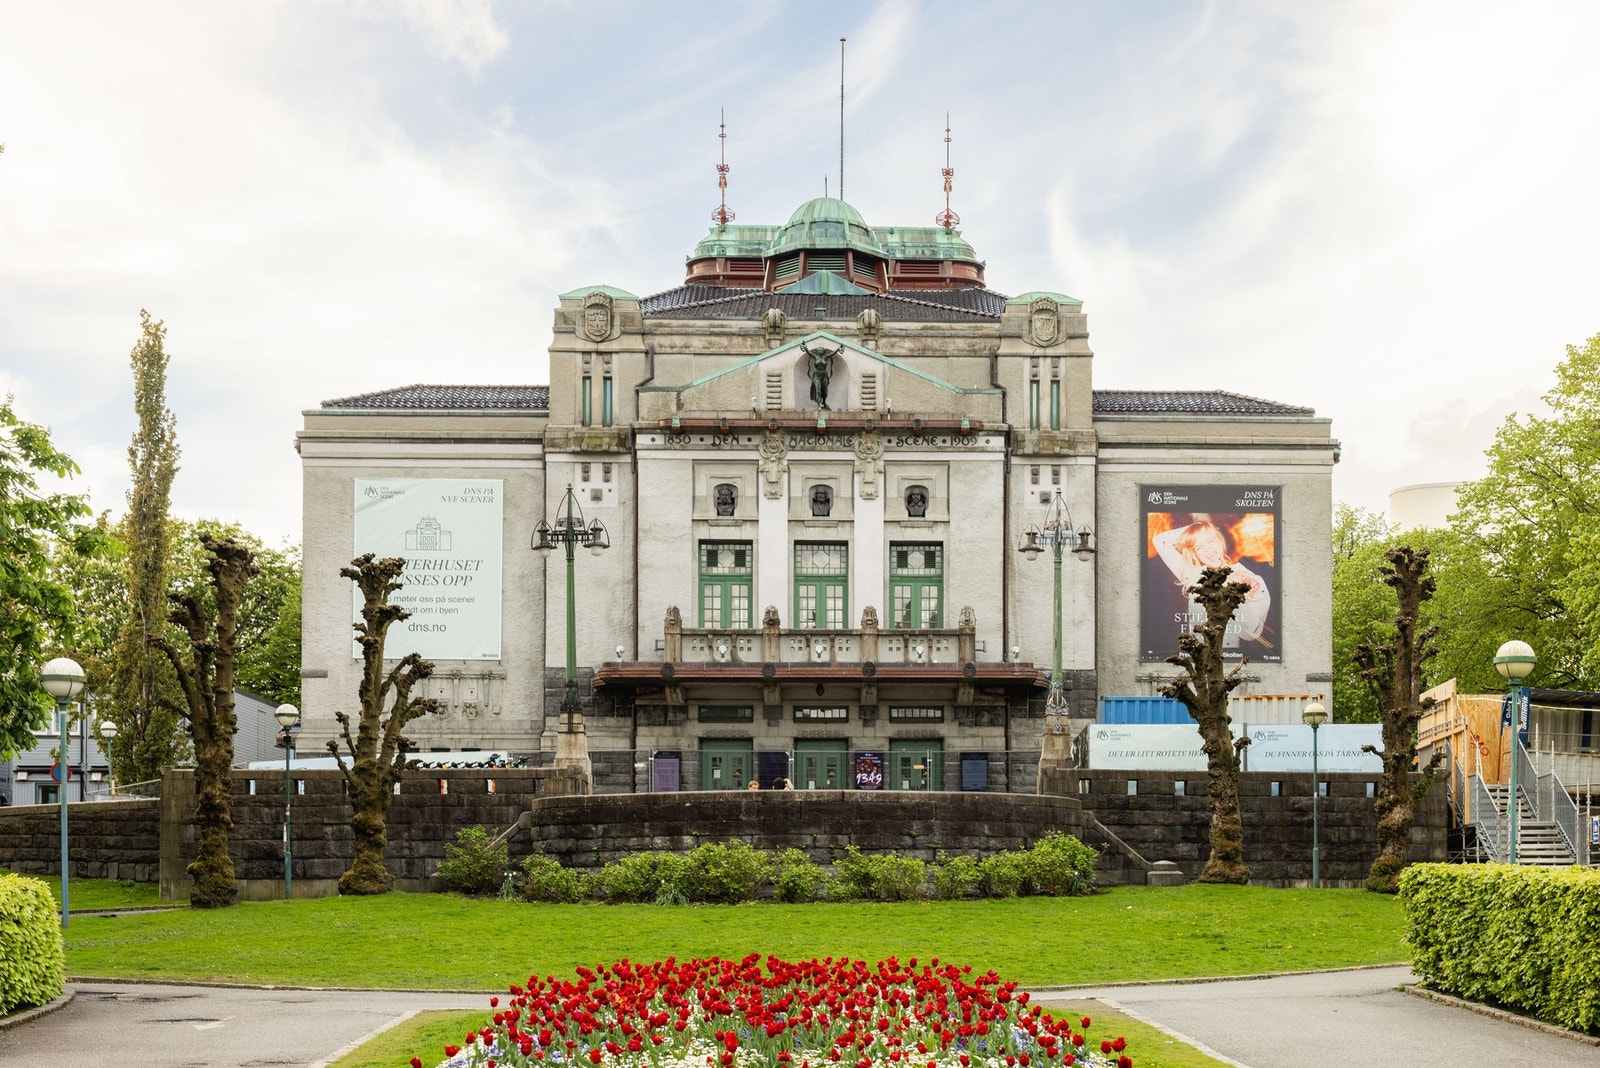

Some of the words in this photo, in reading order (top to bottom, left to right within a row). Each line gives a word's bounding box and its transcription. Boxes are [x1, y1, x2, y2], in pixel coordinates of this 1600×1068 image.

[664, 434, 691, 445] 1850
[711, 434, 739, 447] DEN
[896, 434, 939, 447] SCENE
[950, 435, 978, 446] 1909
[464, 487, 482, 495] DNS
[1243, 491, 1263, 499] DNS
[1263, 489, 1274, 499] PÅ
[460, 495, 494, 503] SCENER
[1235, 499, 1275, 507] SKOLTEN
[403, 559, 484, 571] TERHUSET
[393, 574, 440, 586] USSES
[442, 574, 473, 586] OPP
[393, 595, 418, 603] møter
[435, 595, 446, 604] på
[447, 596, 475, 604] scener
[439, 606, 459, 616] byen
[407, 622, 447, 633] dns.no
[1108, 750, 1125, 758] DET
[1125, 750, 1136, 758] ER
[1137, 750, 1156, 758] LITT
[1156, 750, 1188, 758] ROTETE
[1264, 750, 1278, 758] DU
[1277, 750, 1308, 758] FINNER
[1324, 749, 1335, 758] PÅ
[856, 771, 882, 785] 1349
